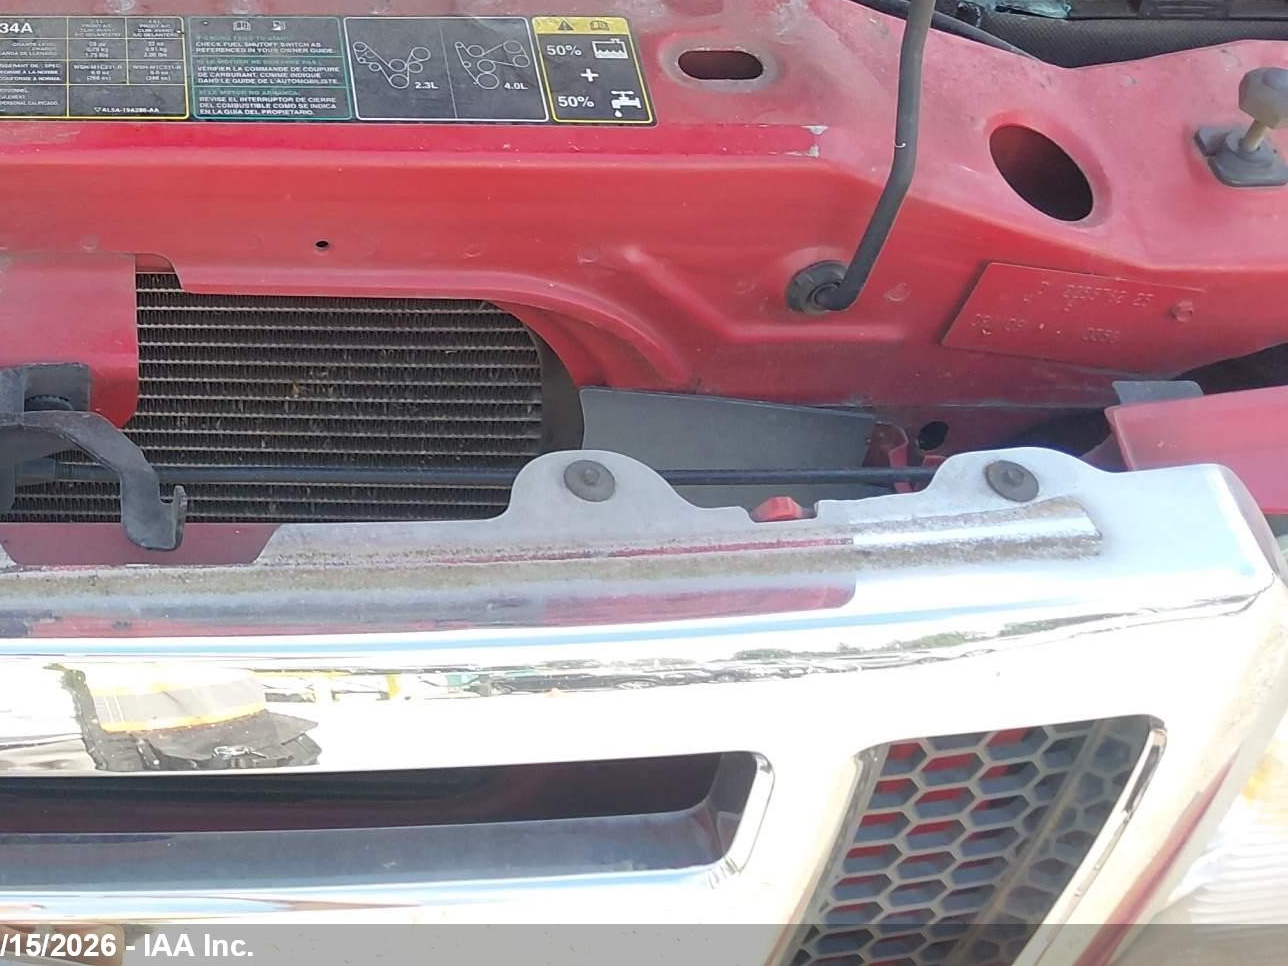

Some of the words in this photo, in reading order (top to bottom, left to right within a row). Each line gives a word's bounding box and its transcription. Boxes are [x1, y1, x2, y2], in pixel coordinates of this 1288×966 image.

[546, 45, 582, 56] 50%
[414, 81, 439, 89] 2.3L
[503, 82, 529, 90] 4.0L
[557, 96, 595, 108] 50%
